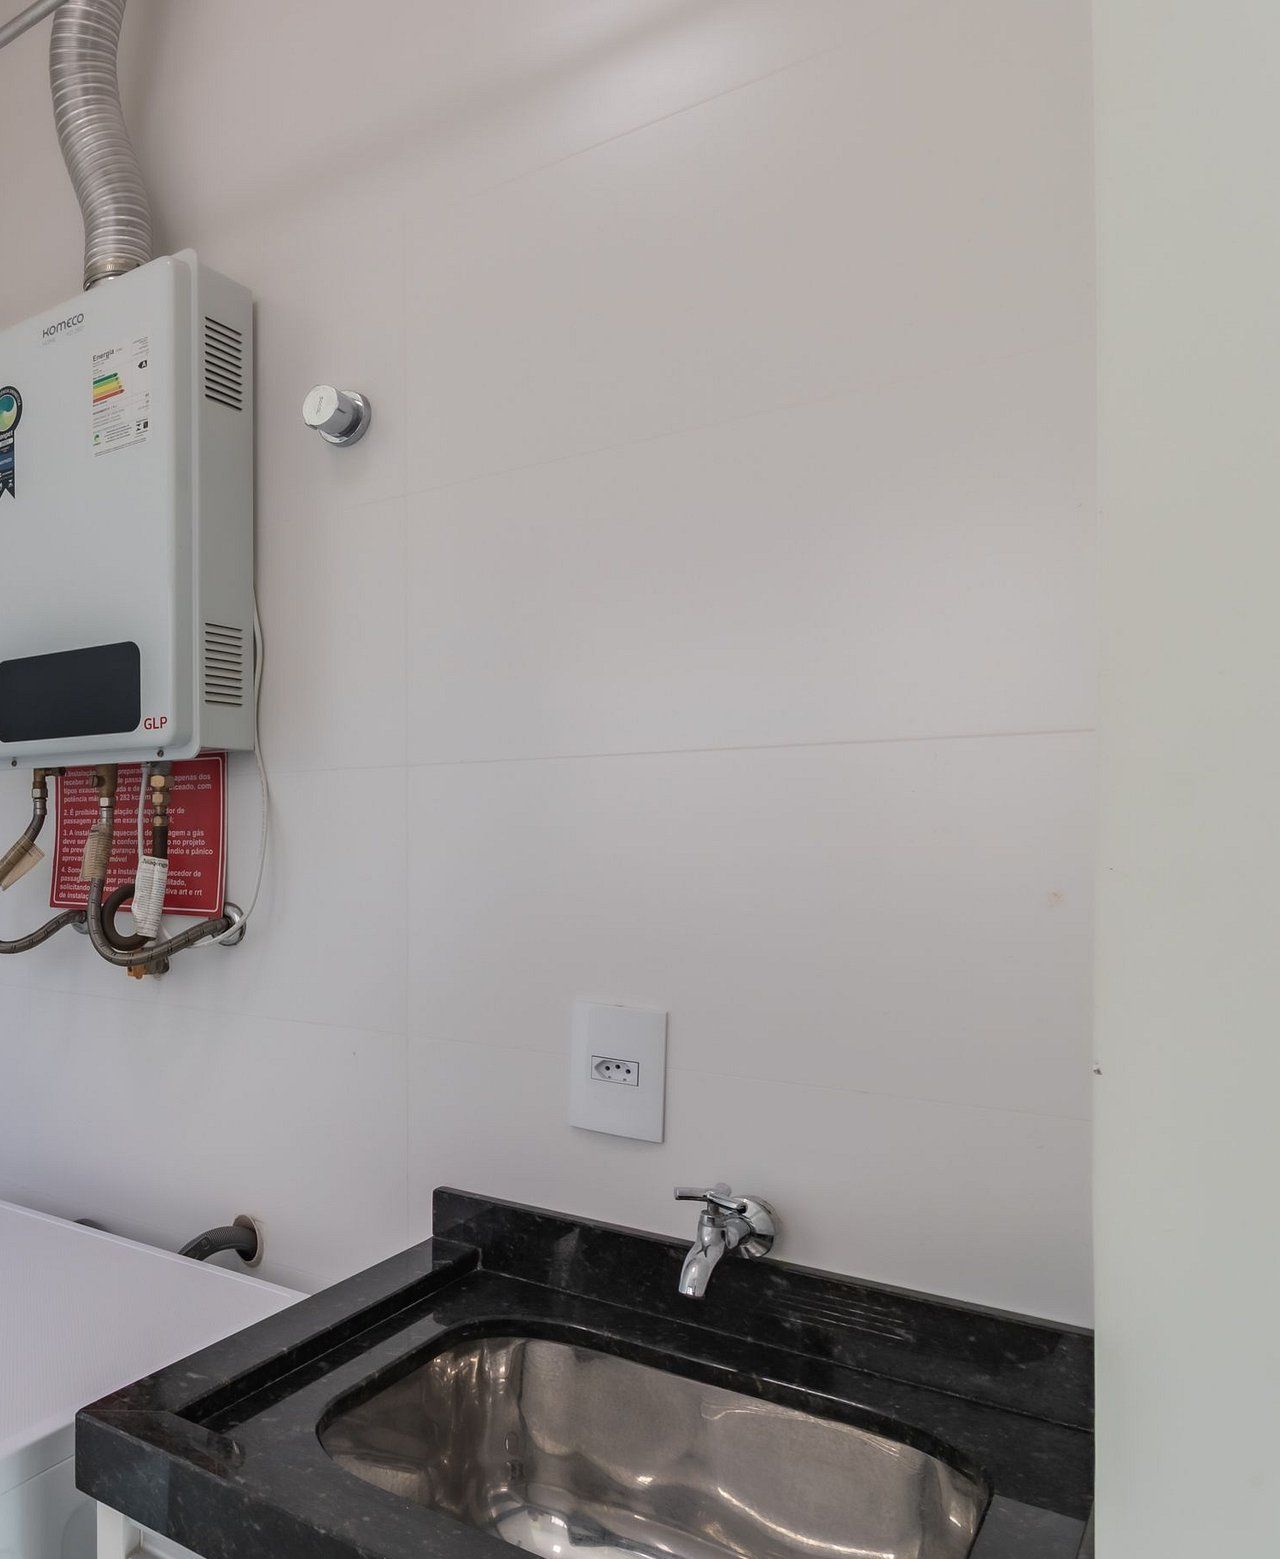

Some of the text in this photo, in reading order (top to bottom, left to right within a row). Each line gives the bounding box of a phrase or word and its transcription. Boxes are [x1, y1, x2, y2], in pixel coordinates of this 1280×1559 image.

[42, 313, 85, 338] KOMECO
[93, 349, 114, 362] Energia
[144, 716, 168, 730] GLP
[182, 839, 206, 848] projeto
[191, 848, 214, 856] pânico
